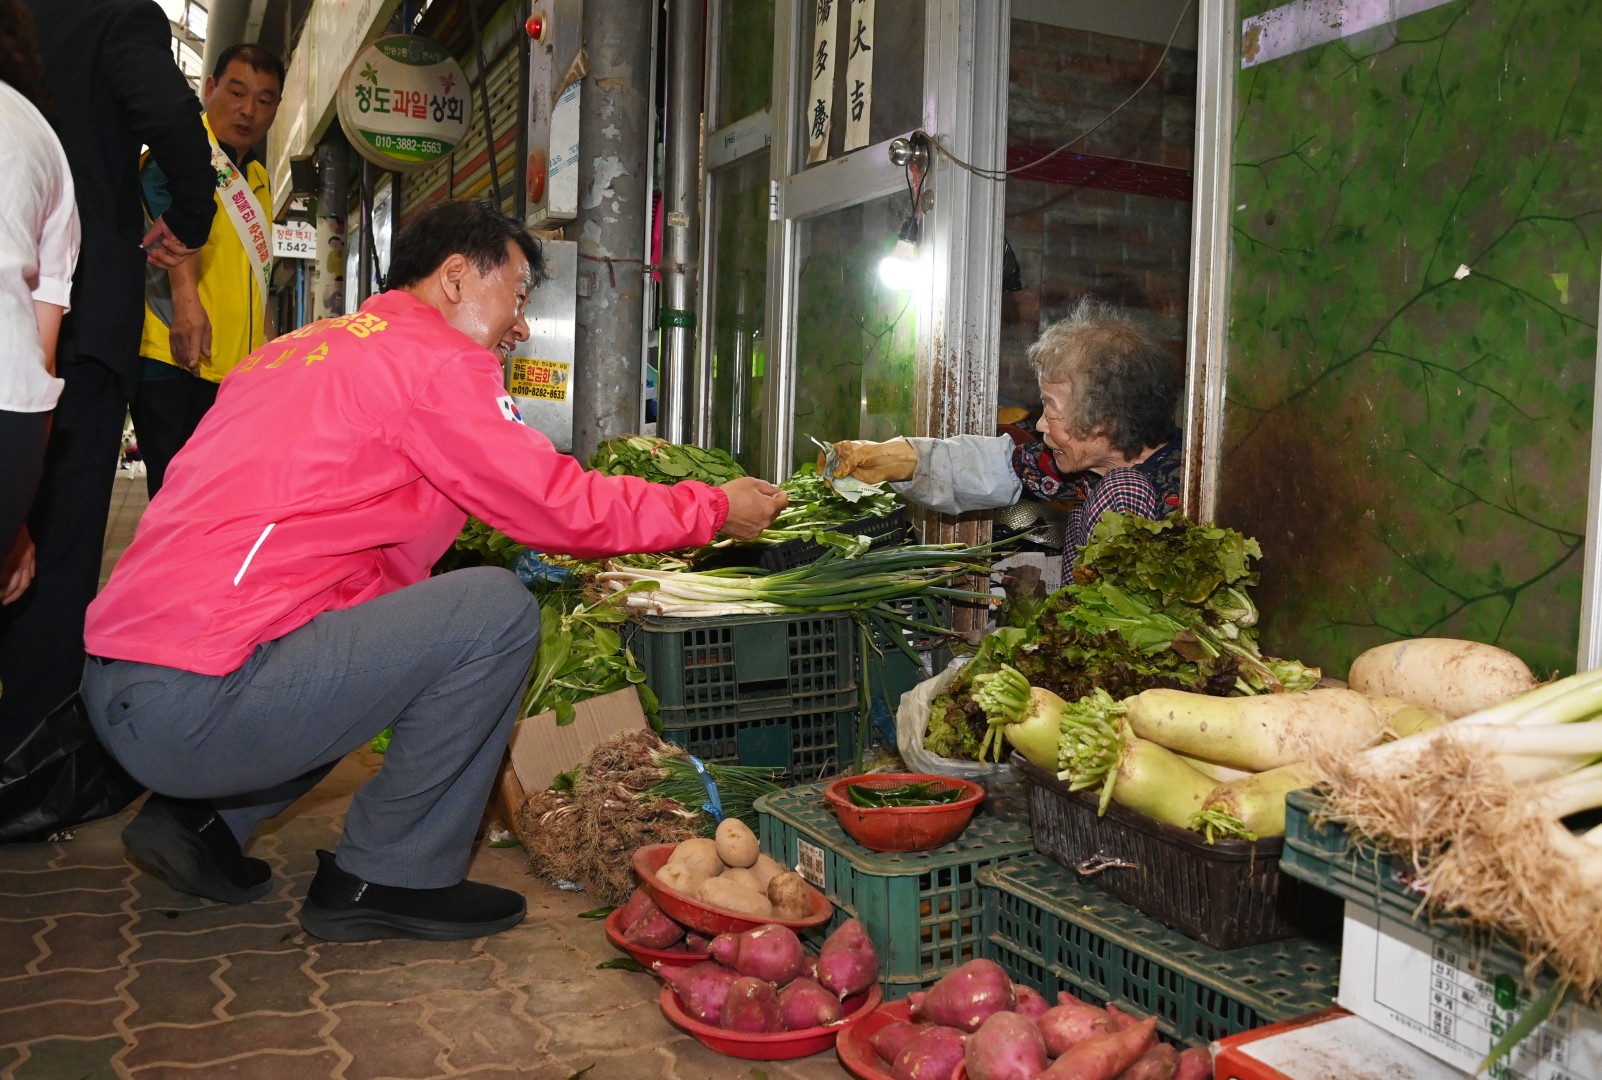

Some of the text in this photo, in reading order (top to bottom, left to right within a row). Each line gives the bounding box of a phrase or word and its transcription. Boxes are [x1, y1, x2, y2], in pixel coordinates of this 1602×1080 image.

[849, 0, 871, 122] 大吉
[355, 84, 464, 125] 청도과일상회
[375, 135, 442, 154] 010-3882-5563
[276, 229, 293, 240] 장판
[514, 364, 526, 372] 카드
[527, 366, 551, 383] 현금화
